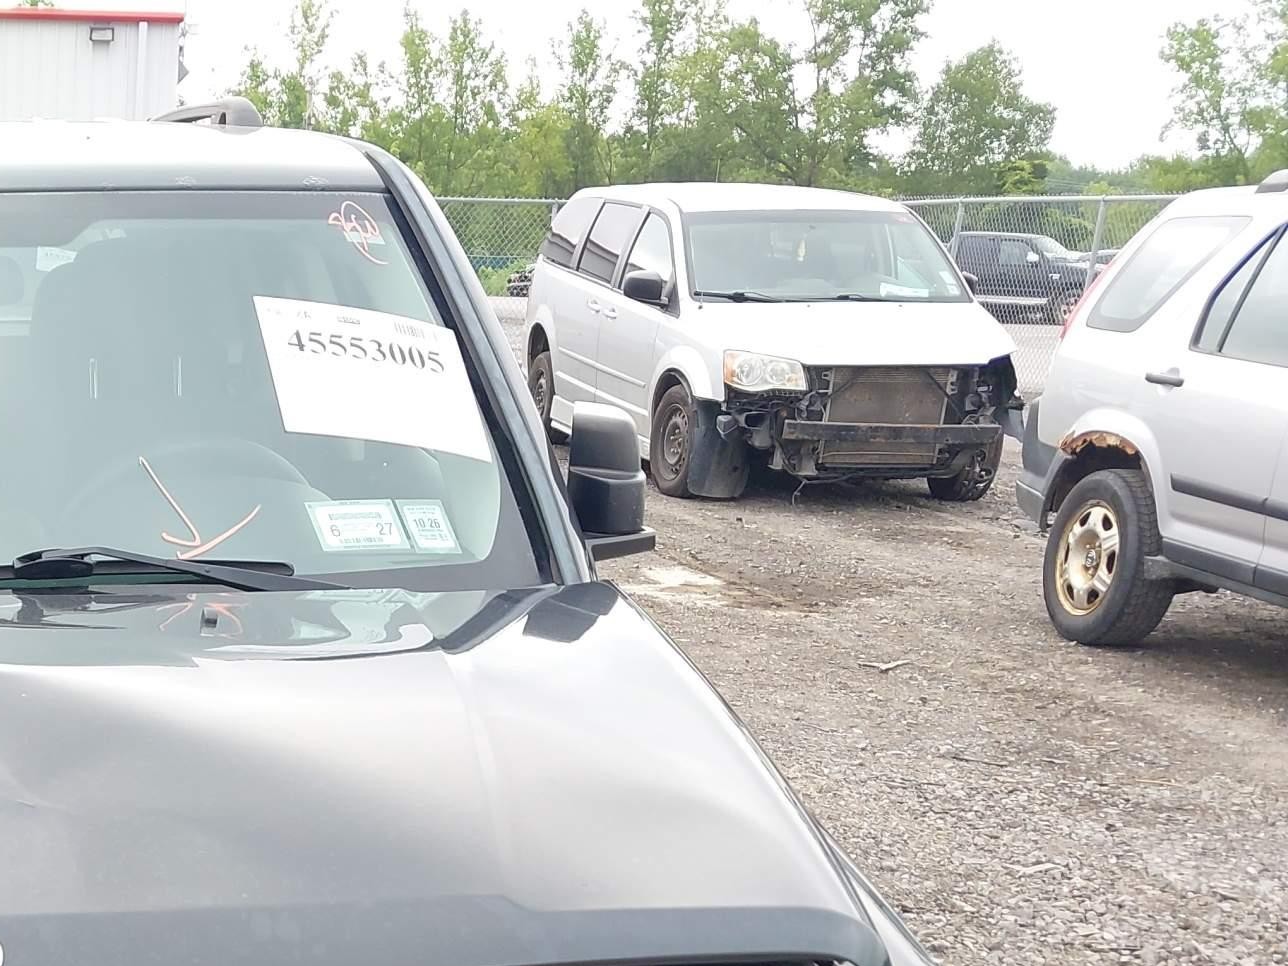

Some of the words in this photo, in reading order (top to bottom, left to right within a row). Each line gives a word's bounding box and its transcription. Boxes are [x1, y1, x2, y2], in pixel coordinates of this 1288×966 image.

[287, 329, 445, 374] 45553005
[330, 524, 341, 536] 6
[376, 522, 393, 535] 27
[412, 518, 426, 529] 10
[427, 518, 441, 529] 26
